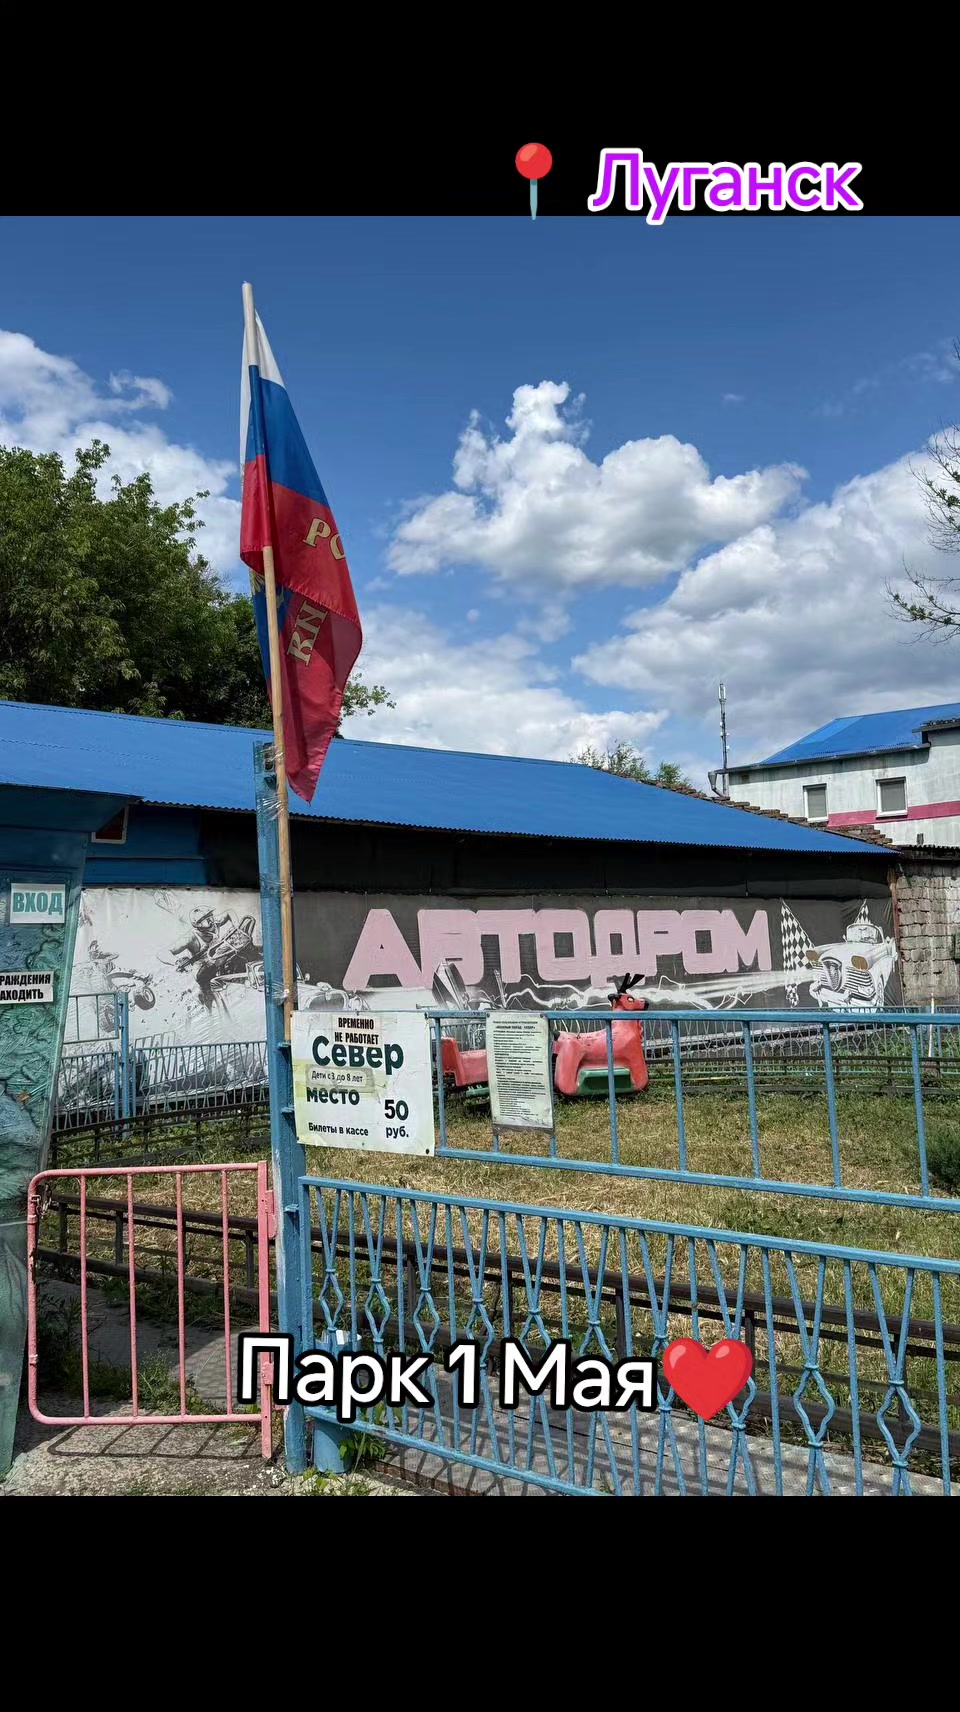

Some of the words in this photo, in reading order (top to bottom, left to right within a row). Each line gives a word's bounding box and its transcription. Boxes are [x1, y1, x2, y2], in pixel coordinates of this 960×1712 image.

[12, 892, 63, 916] ВХОД
[342, 908, 772, 988] АВТОДРОМ
[338, 1017, 374, 1030] ВРЕМЕННО
[334, 1032, 343, 1043] НЕ
[345, 1032, 379, 1045] РАБОТАЕТ
[312, 1035, 404, 1076] Север
[311, 1070, 327, 1080] Дети
[336, 1074, 346, 1083] до
[346, 1073, 351, 1082] 8
[306, 1086, 360, 1106] место
[384, 1099, 409, 1121] 50
[308, 1122, 337, 1134] Билеты
[345, 1127, 369, 1136] кассе
[385, 1126, 410, 1139] руб.
